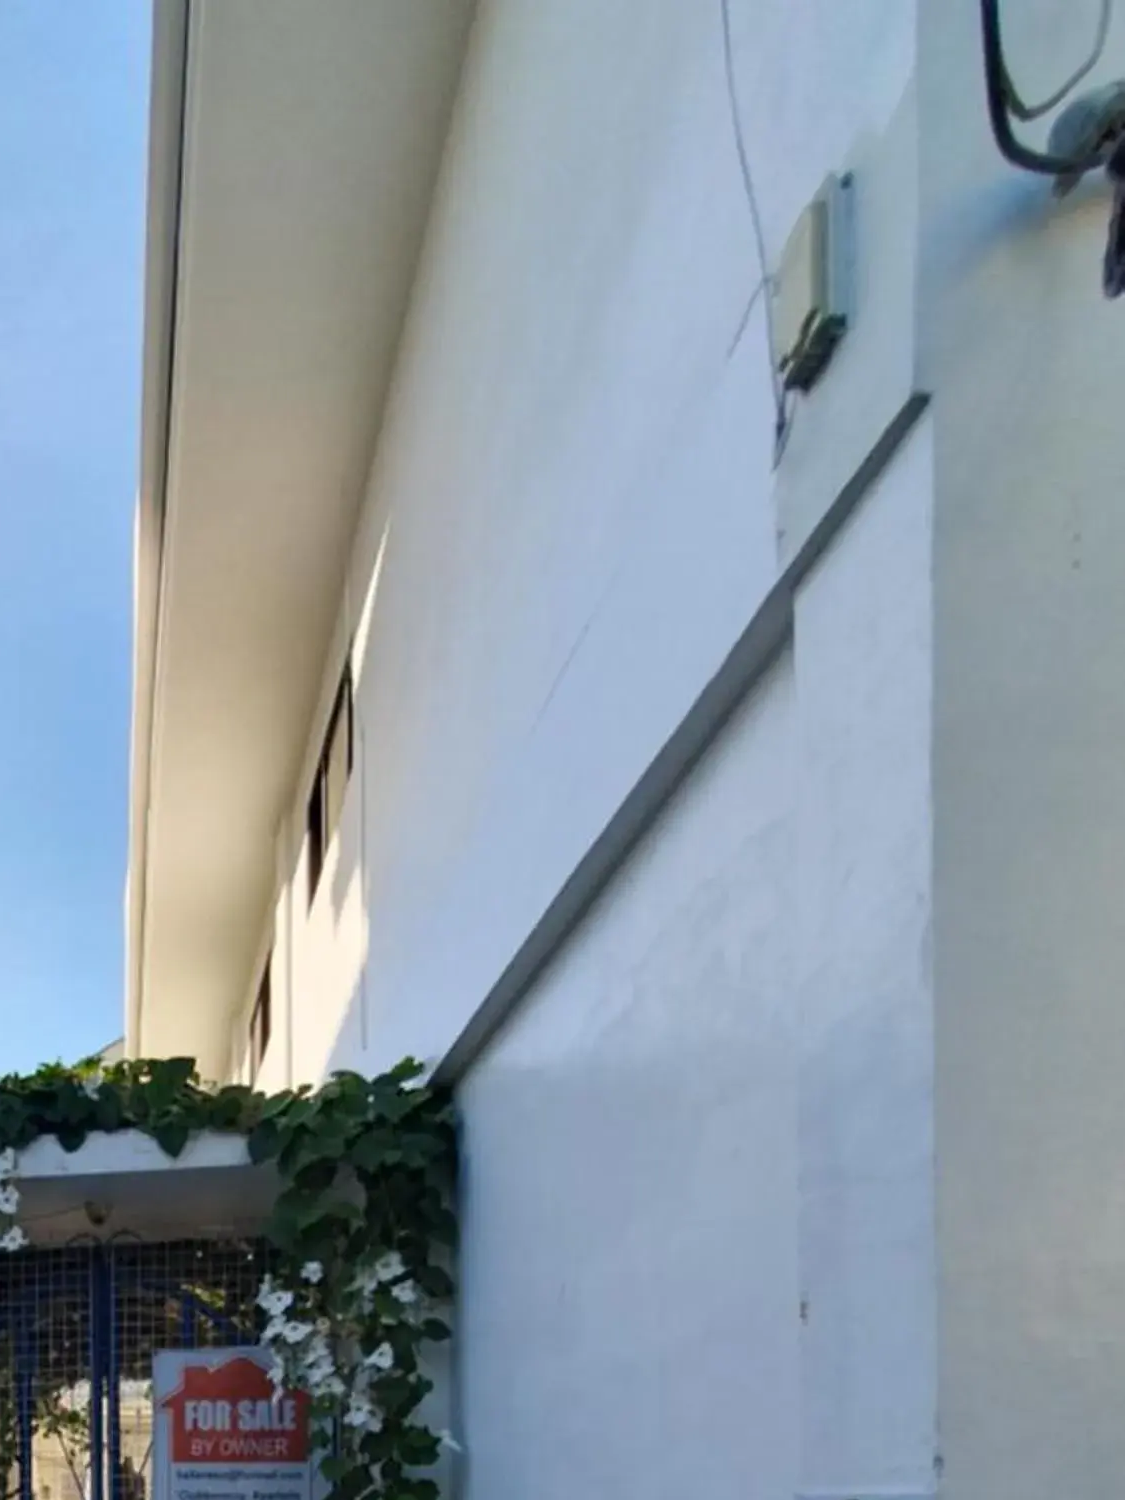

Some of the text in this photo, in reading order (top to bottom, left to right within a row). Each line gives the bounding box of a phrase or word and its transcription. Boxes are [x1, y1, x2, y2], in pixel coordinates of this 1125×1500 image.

[184, 1400, 296, 1431] FOR SALE
[190, 1437, 289, 1457] BY OWNER
